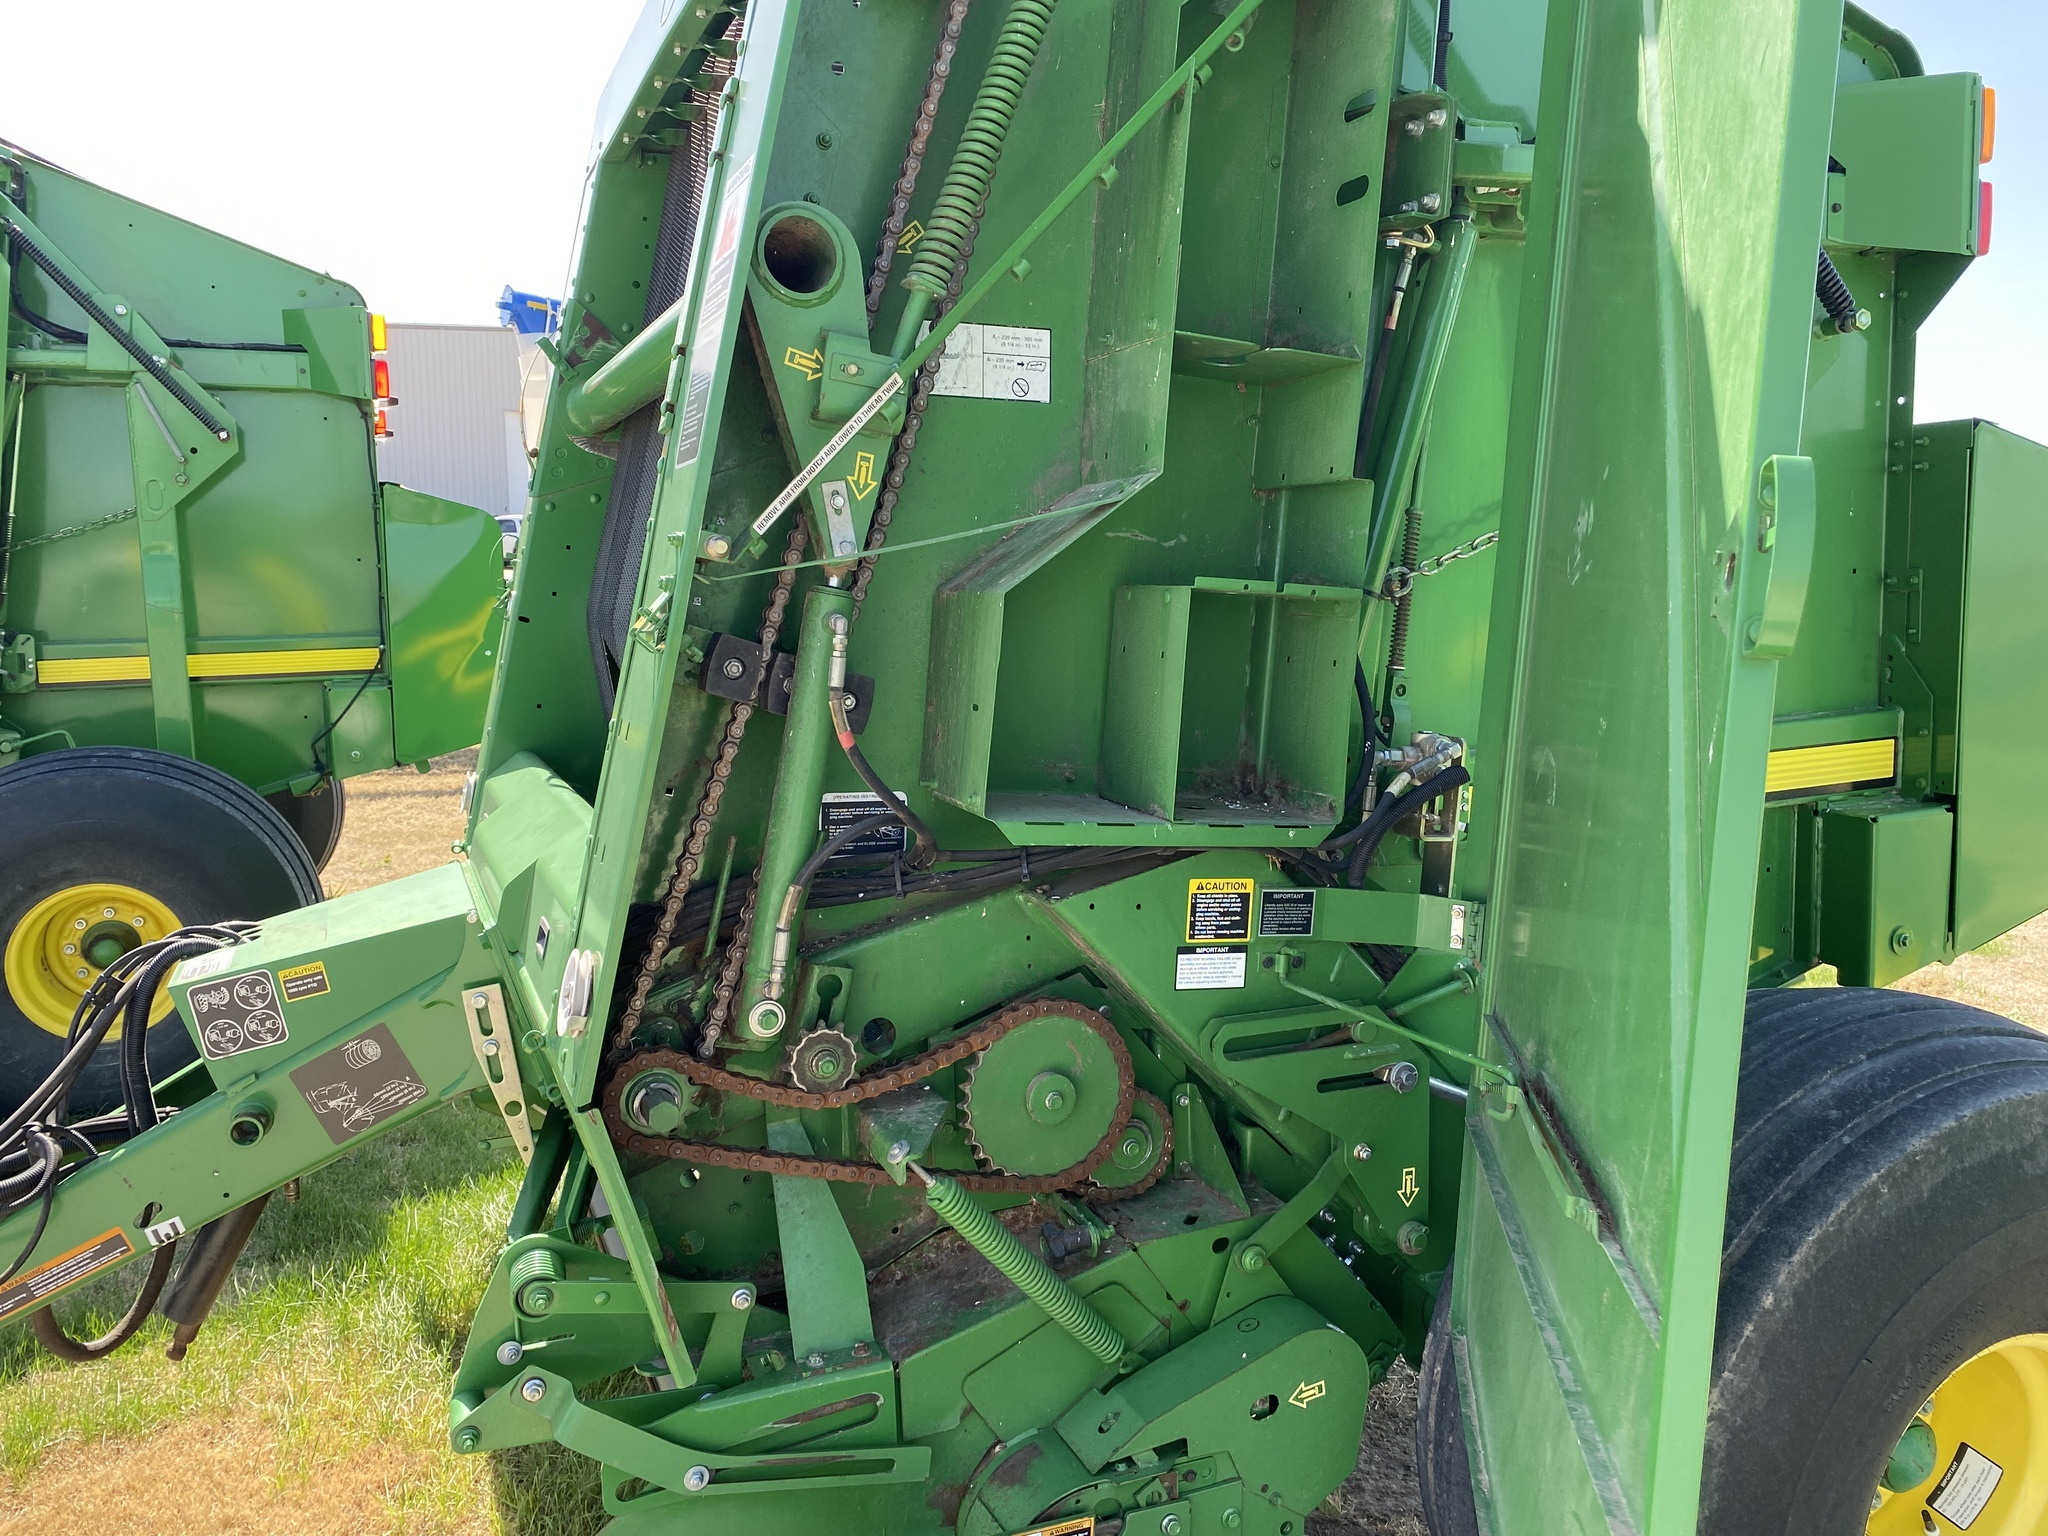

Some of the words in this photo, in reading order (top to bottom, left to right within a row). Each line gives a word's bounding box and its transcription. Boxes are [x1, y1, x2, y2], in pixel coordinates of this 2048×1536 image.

[757, 505, 780, 531] REMOVE
[778, 491, 792, 509] ARM
[790, 474, 807, 494] FROM
[806, 455, 826, 476] NOTCH
[824, 443, 837, 458] AND
[834, 424, 856, 446] LOWER
[854, 415, 863, 426] TO
[862, 395, 883, 418] THREAD
[882, 377, 900, 397] TWINE
[1205, 882, 1247, 890] CAUTION
[288, 966, 320, 977] CAUTION
[6, 1267, 45, 1289] WARNING
[1940, 1461, 1958, 1488] IMPORTANT
[1055, 1523, 1083, 1534] WARNING
